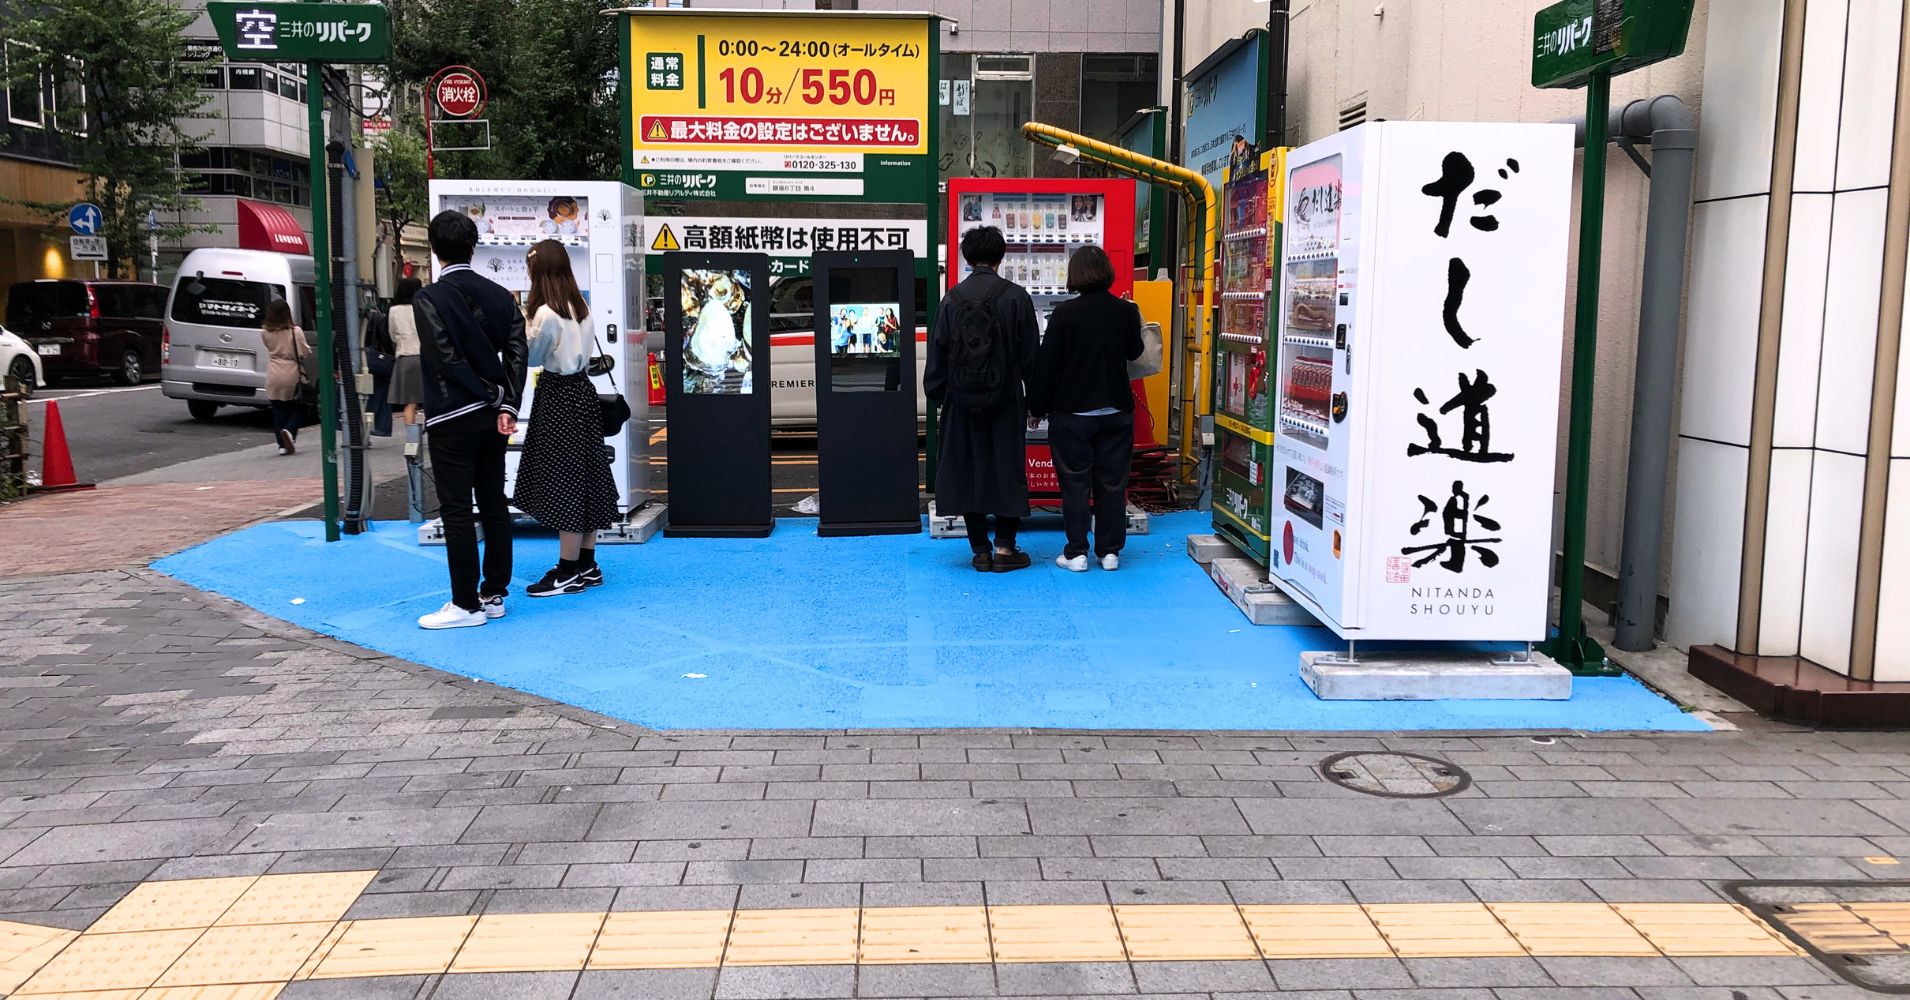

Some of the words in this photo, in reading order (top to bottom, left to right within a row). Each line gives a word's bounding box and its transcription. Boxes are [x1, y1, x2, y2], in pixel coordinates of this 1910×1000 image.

[236, 9, 278, 49] 空
[280, 20, 372, 42] 三井のリパーク
[1537, 16, 1592, 58] 三井のリパーク
[651, 56, 679, 71] 通常
[651, 73, 679, 87] 料金
[442, 87, 476, 103] 消火栓
[670, 120, 915, 142] 最大料金の設定はございません。
[792, 161, 857, 170] 0120-325-130
[660, 174, 716, 188] 三井のリパーク
[683, 225, 910, 252] 高額紙幣は使用不可
[769, 259, 809, 274] カード
[1401, 151, 1520, 574] だし道楽
[1412, 587, 1494, 599] NITANDA
[1410, 603, 1494, 615] SHOUYU
